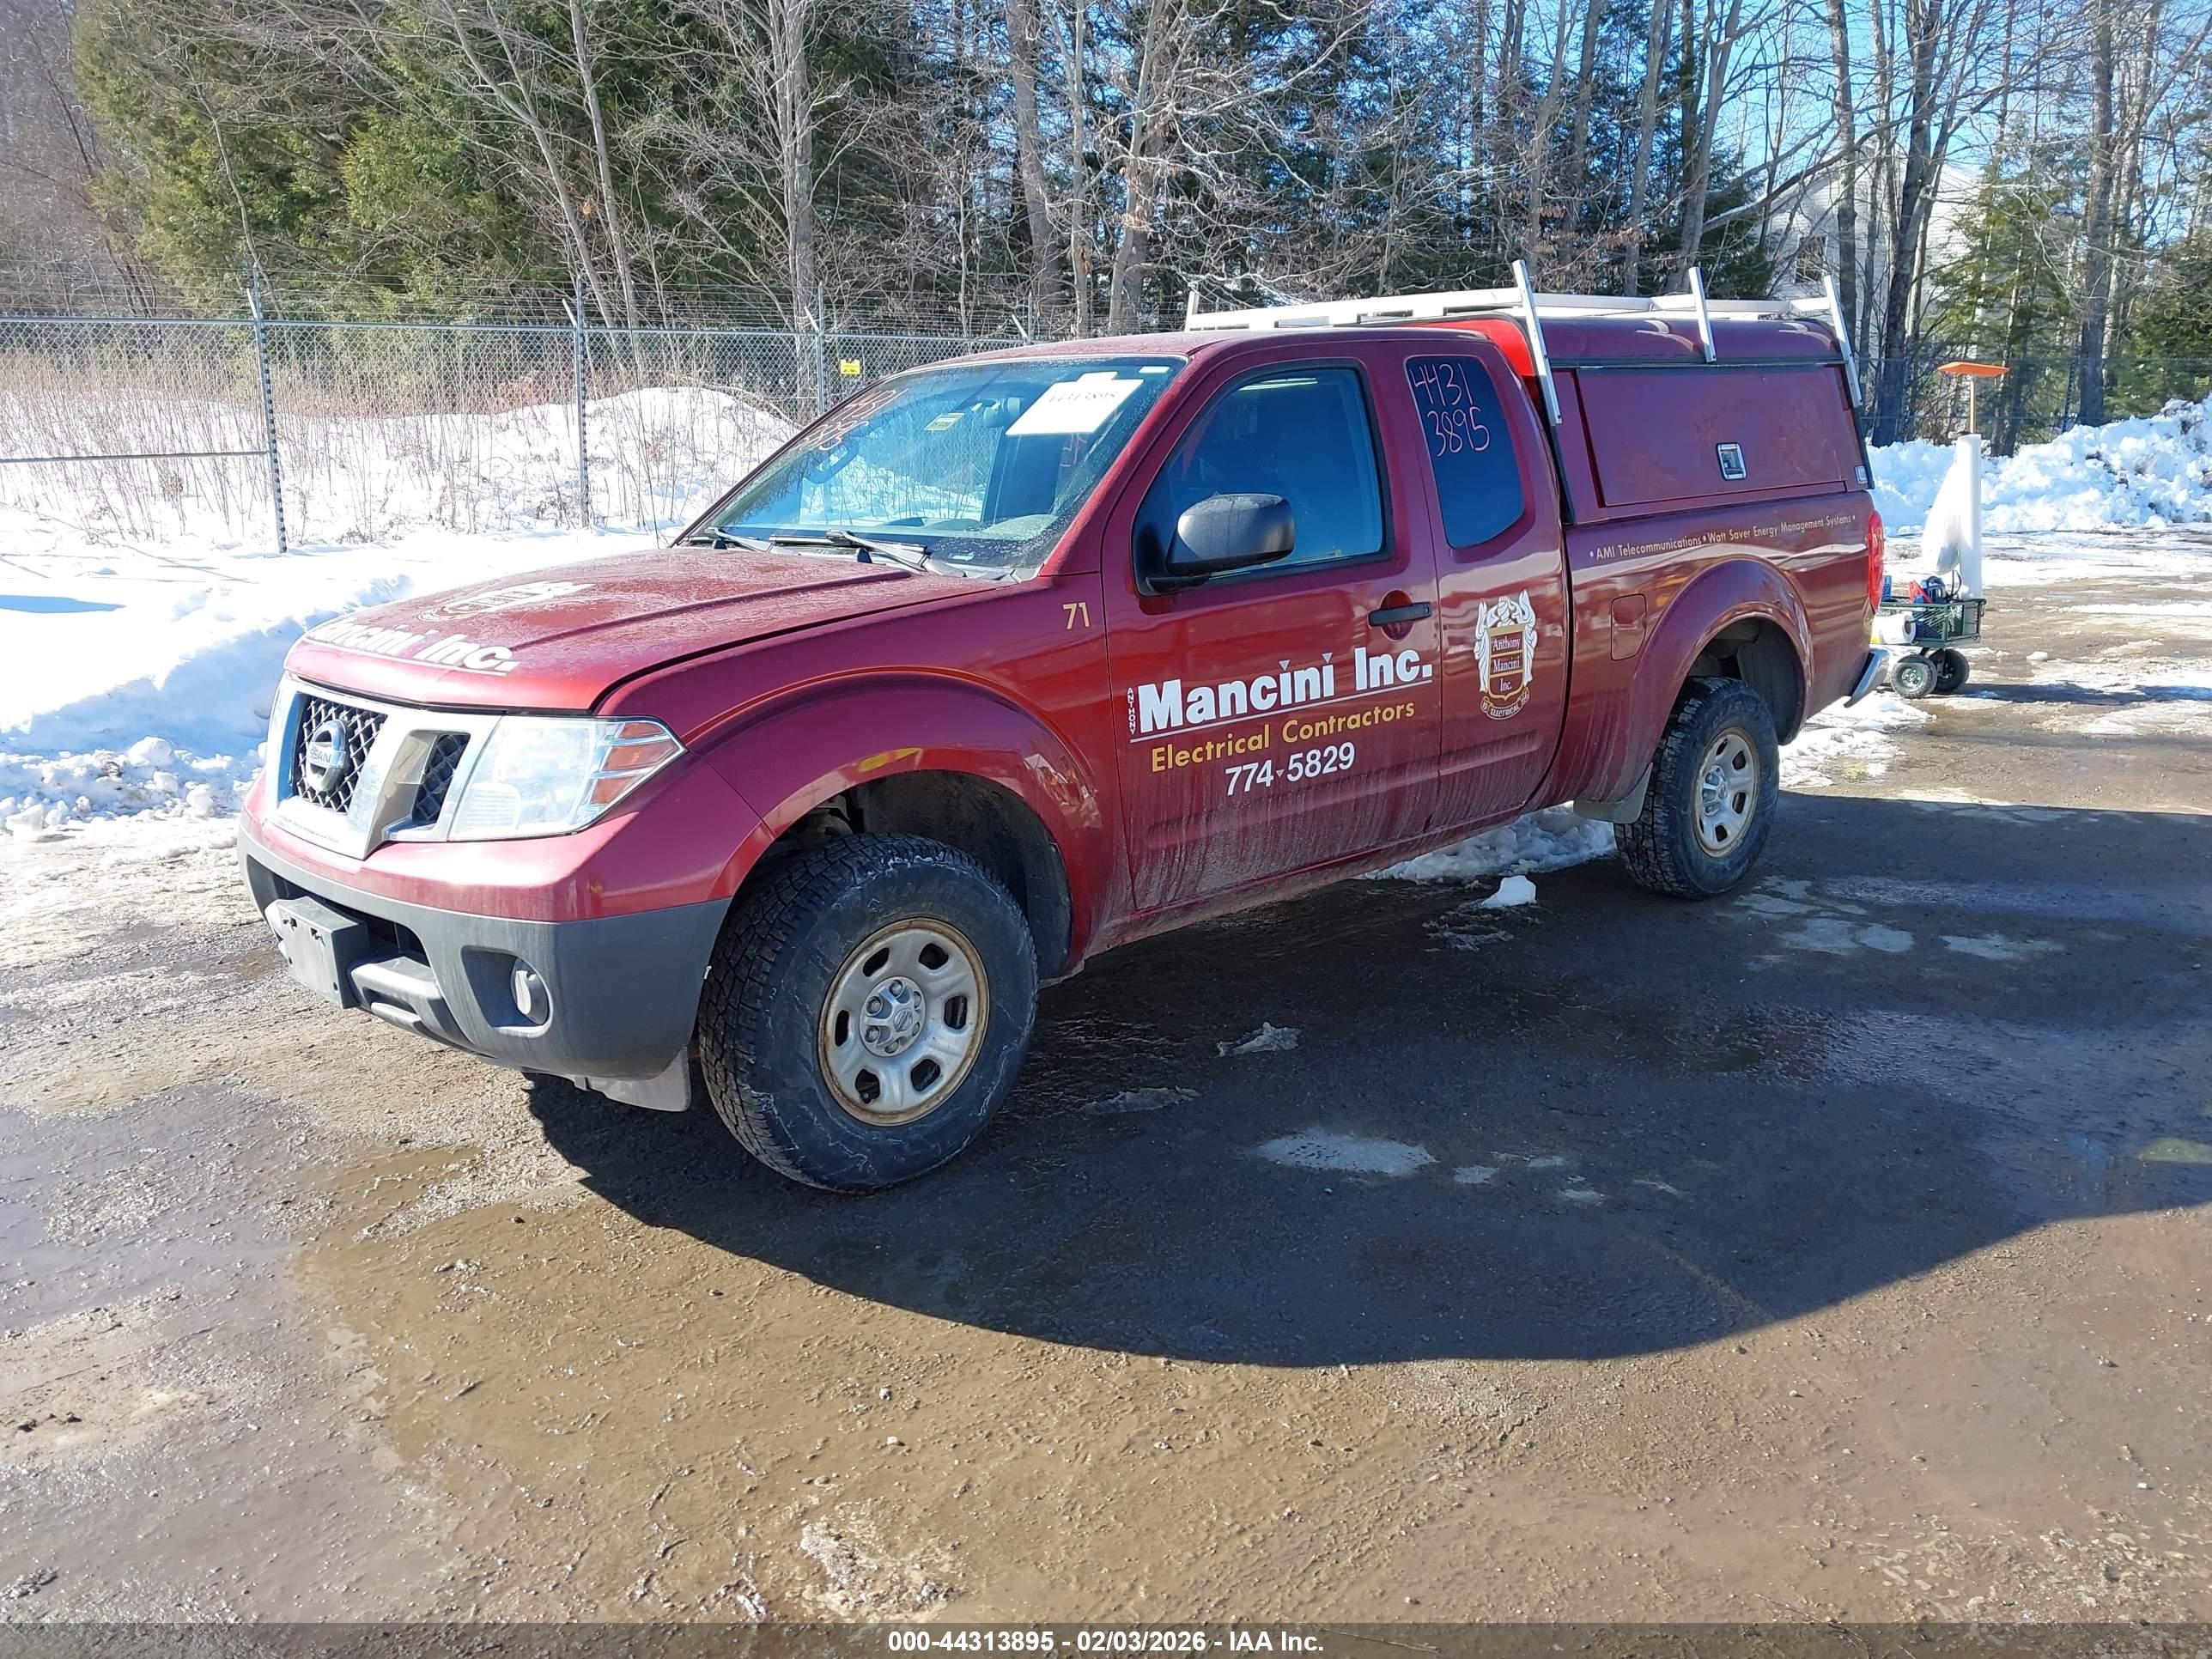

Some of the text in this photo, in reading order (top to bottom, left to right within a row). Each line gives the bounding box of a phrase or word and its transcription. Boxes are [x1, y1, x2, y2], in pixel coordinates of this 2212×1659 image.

[1408, 362, 1474, 407] 4431
[1426, 405, 1491, 457] 3895
[1707, 515, 1851, 543] Watt Saver Energy Management Systems
[1596, 535, 1702, 560] AMI Telecommunications
[1062, 602, 1091, 629] 71
[412, 633, 520, 673] Inc.
[1492, 635, 1521, 652] Anthony
[1493, 655, 1521, 672] Mancini
[1137, 647, 1433, 733] Mancini Inc.
[1499, 678, 1512, 692] Inc.
[1127, 687, 1136, 736] ANTHONY
[1490, 702, 1520, 717] ELECTRICAL
[1152, 701, 1416, 773] Electrical Contractors
